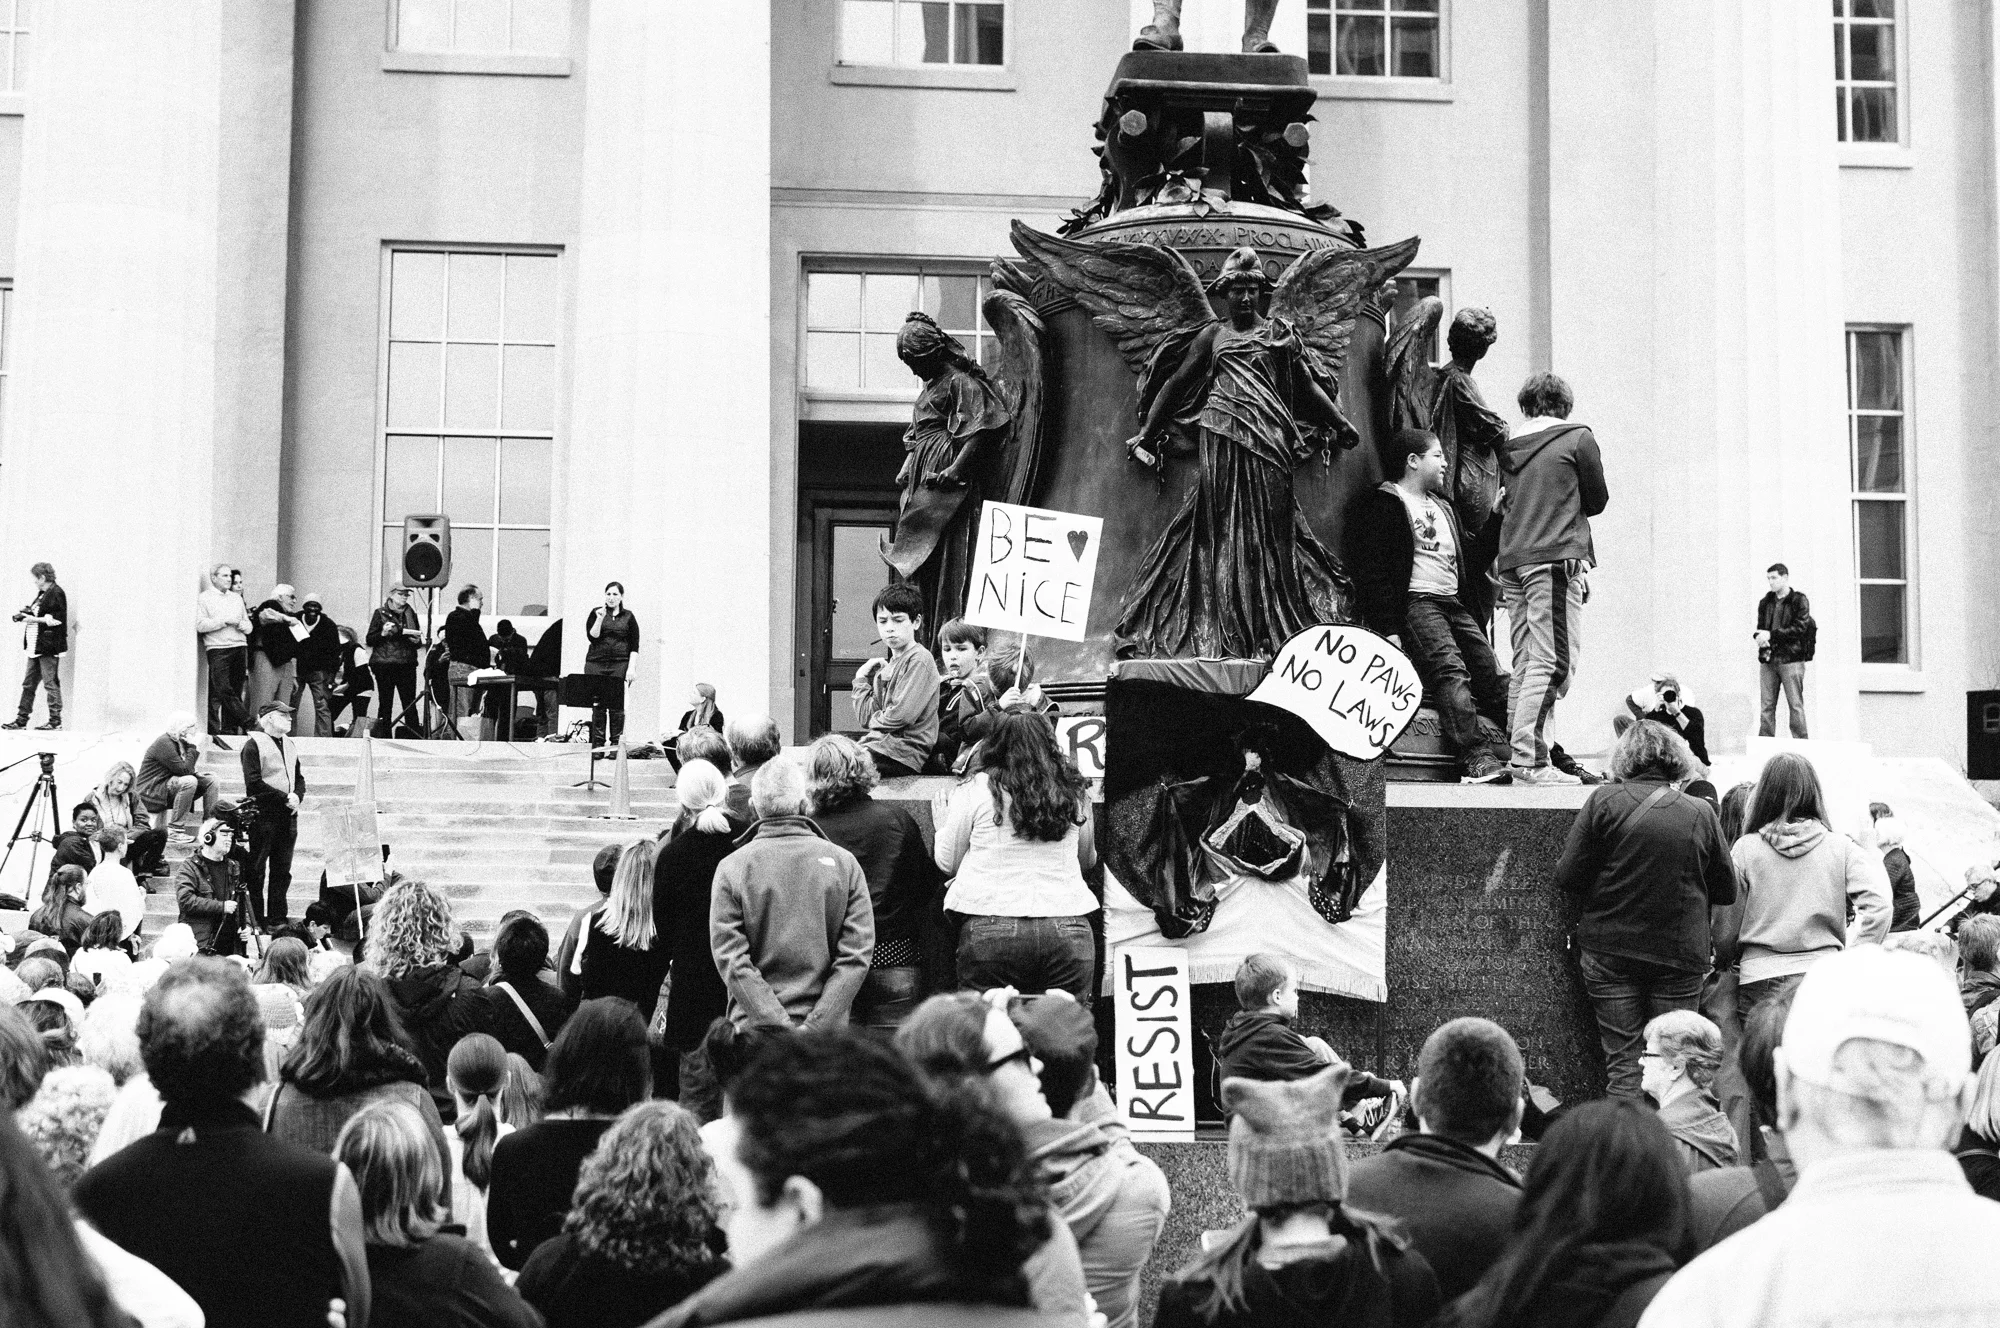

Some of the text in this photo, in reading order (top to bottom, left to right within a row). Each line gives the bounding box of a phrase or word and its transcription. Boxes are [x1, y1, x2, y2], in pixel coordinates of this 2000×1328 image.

[990, 507, 1058, 565] BE
[1280, 653, 1394, 748] NO LAWS
[1314, 629, 1416, 711] NO PAWS
[1124, 953, 1185, 1122] RESIST
